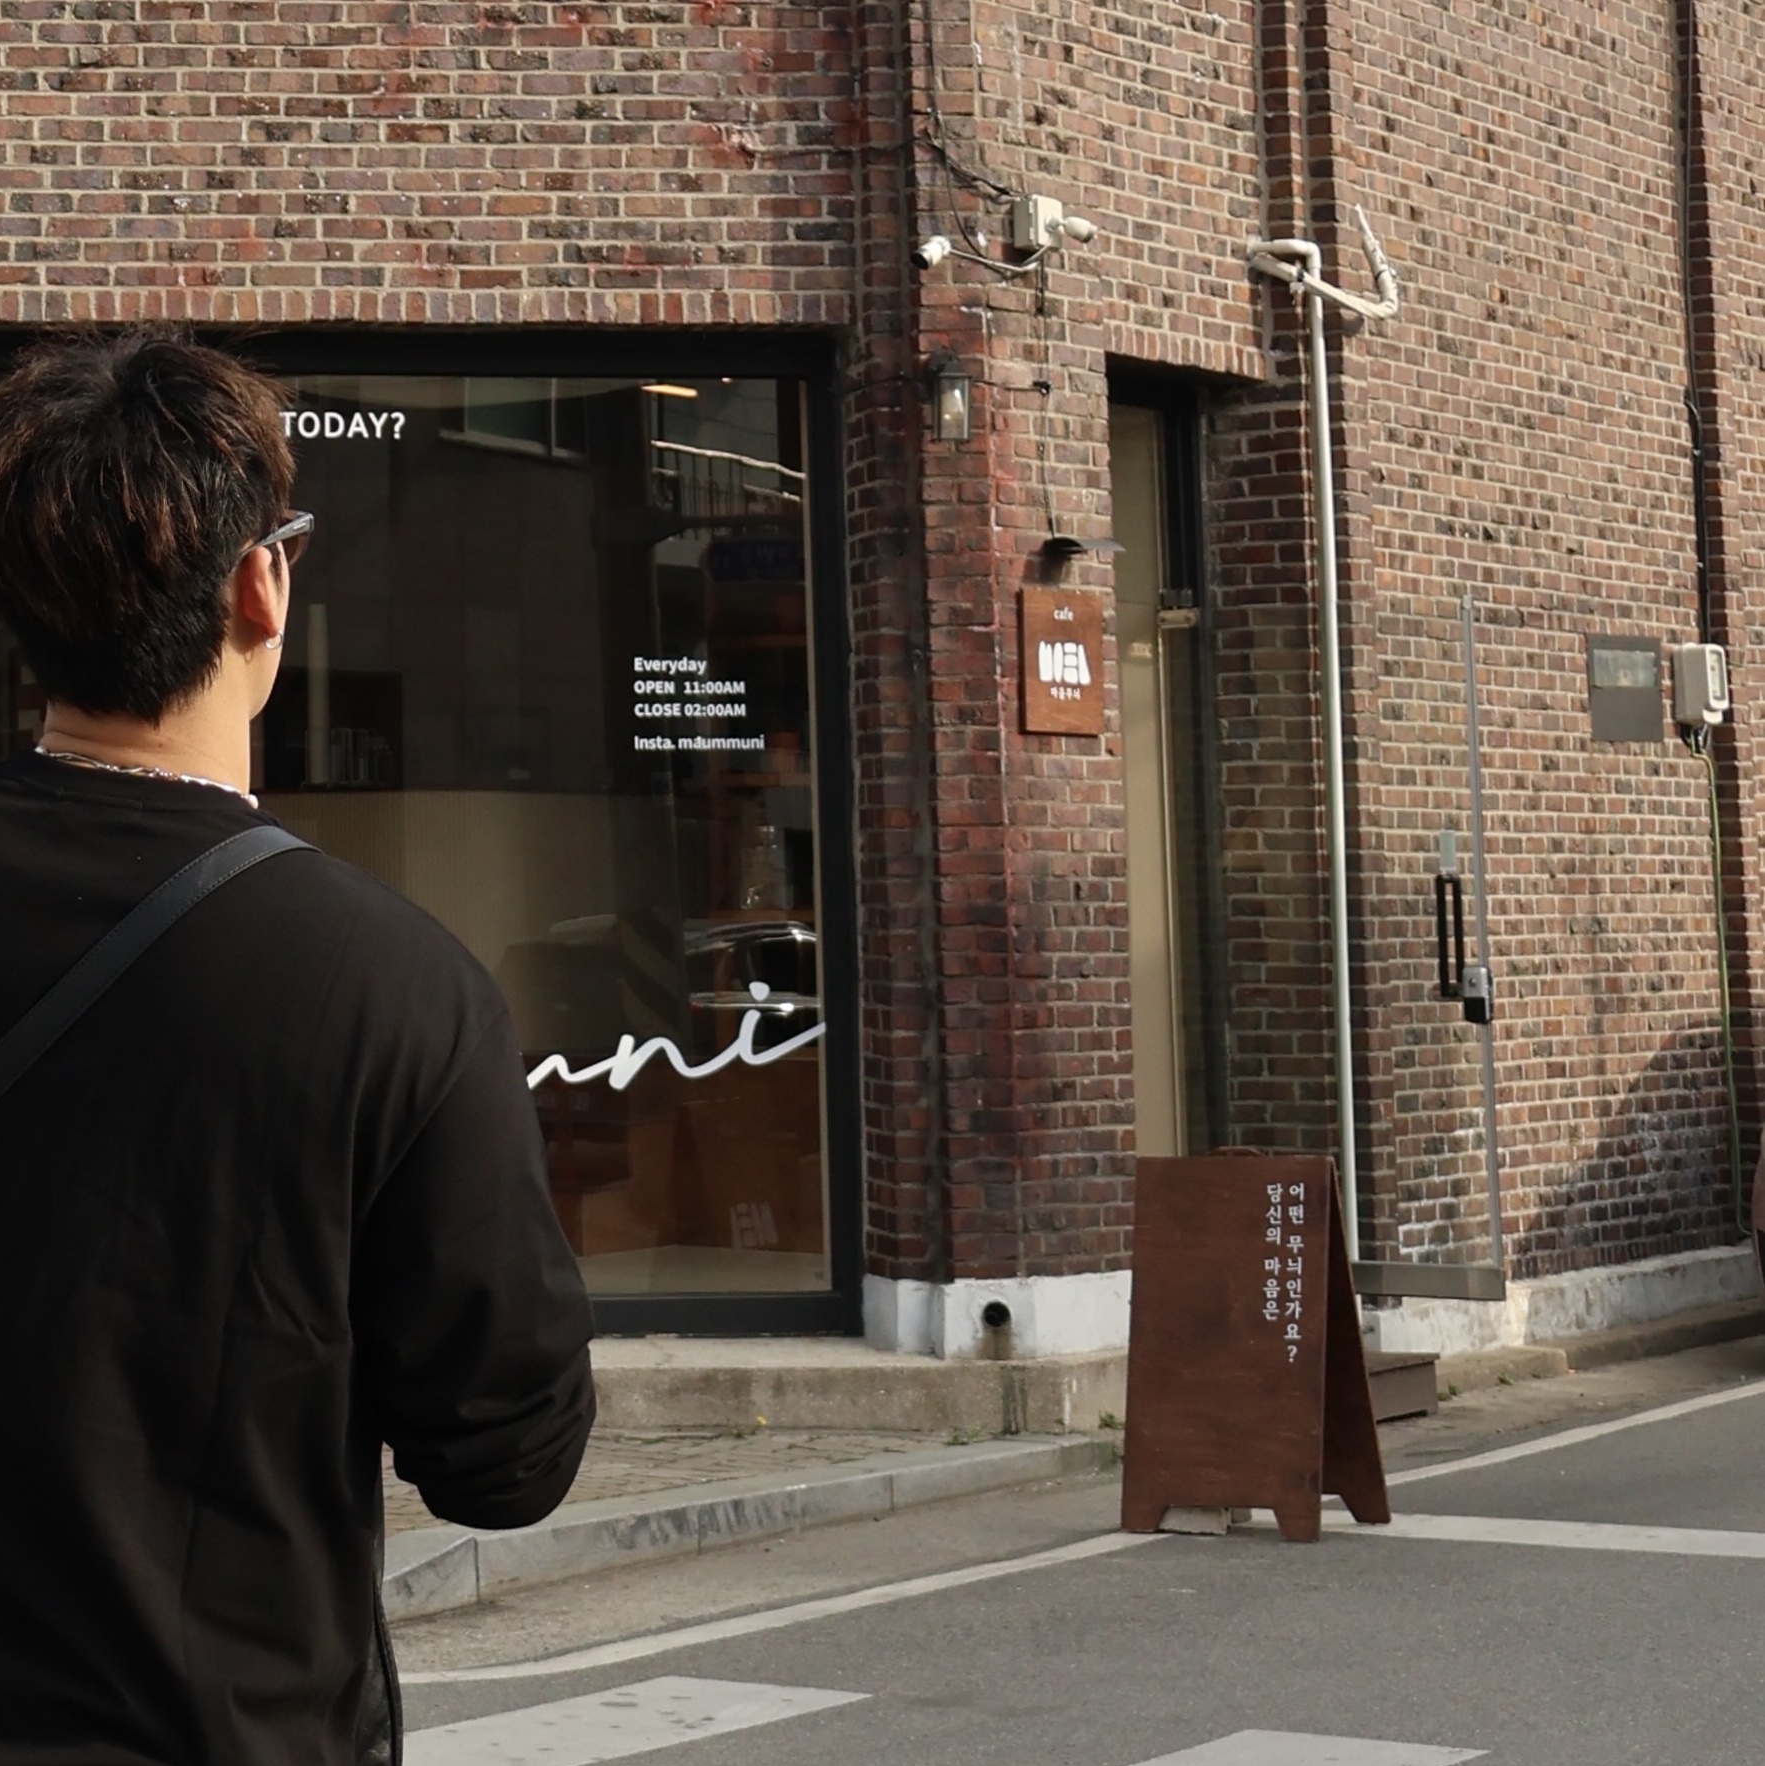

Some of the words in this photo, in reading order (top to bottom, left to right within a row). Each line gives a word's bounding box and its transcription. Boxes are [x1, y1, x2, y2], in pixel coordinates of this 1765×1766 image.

[280, 409, 406, 440] TODAY?
[1053, 606, 1074, 622] cafe
[634, 656, 707, 675] Everyday
[634, 681, 675, 694] OPEN
[683, 681, 745, 694] 11:00AM
[634, 703, 681, 717] CLOSE
[684, 703, 746, 717] 02:00AM
[634, 735, 676, 750] Insta.
[678, 735, 765, 750] maummuni
[1265, 1183, 1284, 1245] 당신의
[1288, 1182, 1305, 1224] 어떤
[1262, 1257, 1282, 1320] 마음은
[1284, 1234, 1305, 1362] 무늬인가요?
